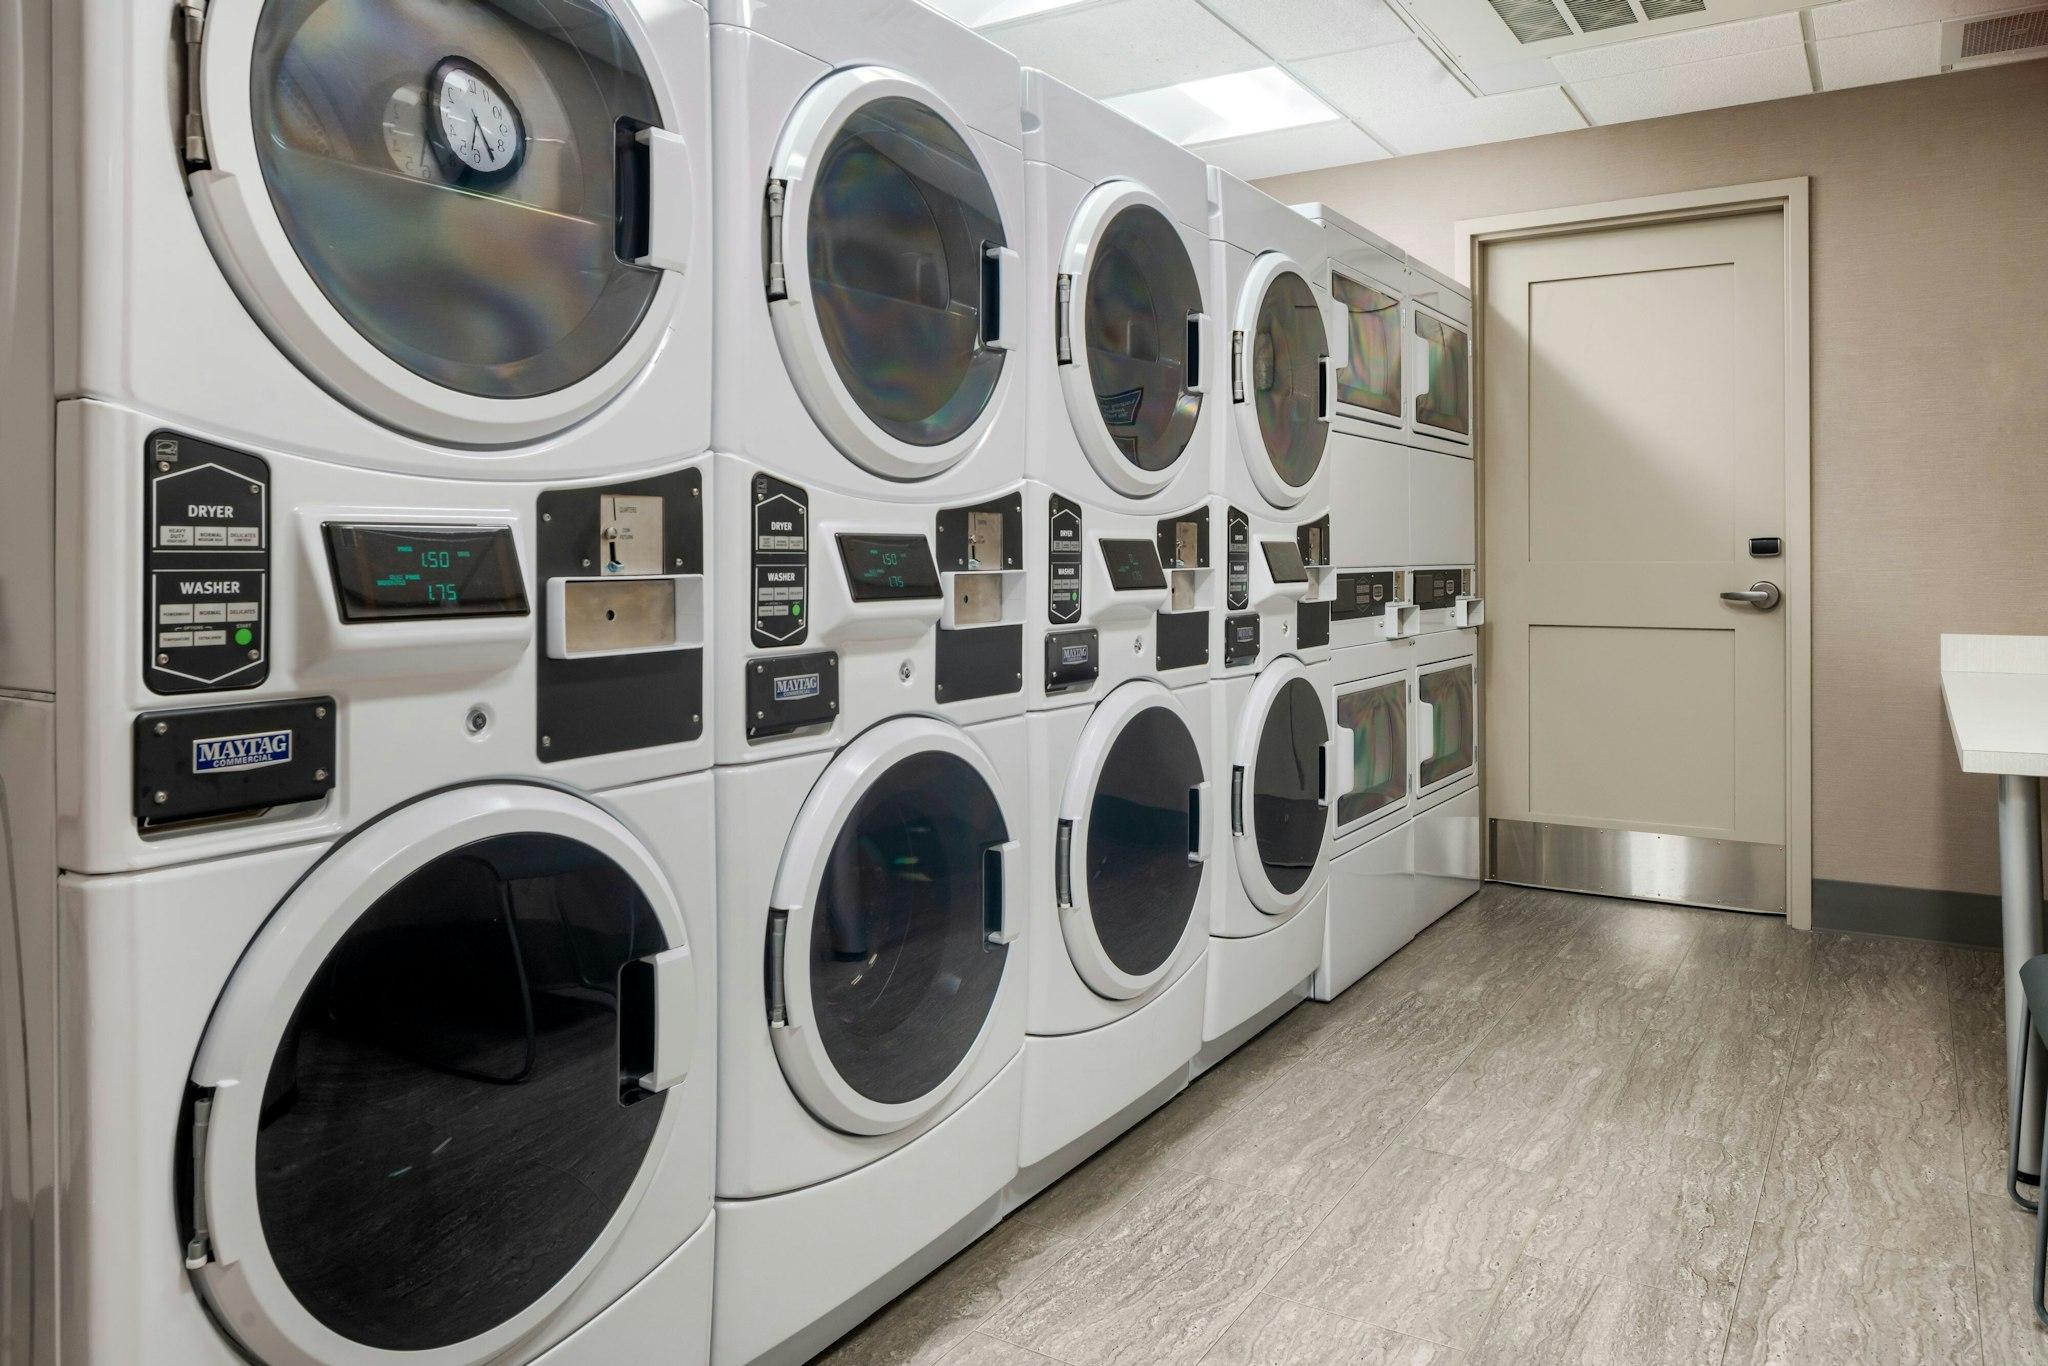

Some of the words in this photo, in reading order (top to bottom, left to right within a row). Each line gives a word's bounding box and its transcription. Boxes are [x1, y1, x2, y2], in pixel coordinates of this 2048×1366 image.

[187, 504, 234, 518] DRYER
[771, 521, 793, 531] DRYER
[767, 572, 796, 582] WASHER
[180, 581, 240, 595] WASHER
[776, 676, 817, 693] MAYTAG
[199, 734, 287, 762] MAYTAG
[212, 753, 273, 768] COMMERCIAL
